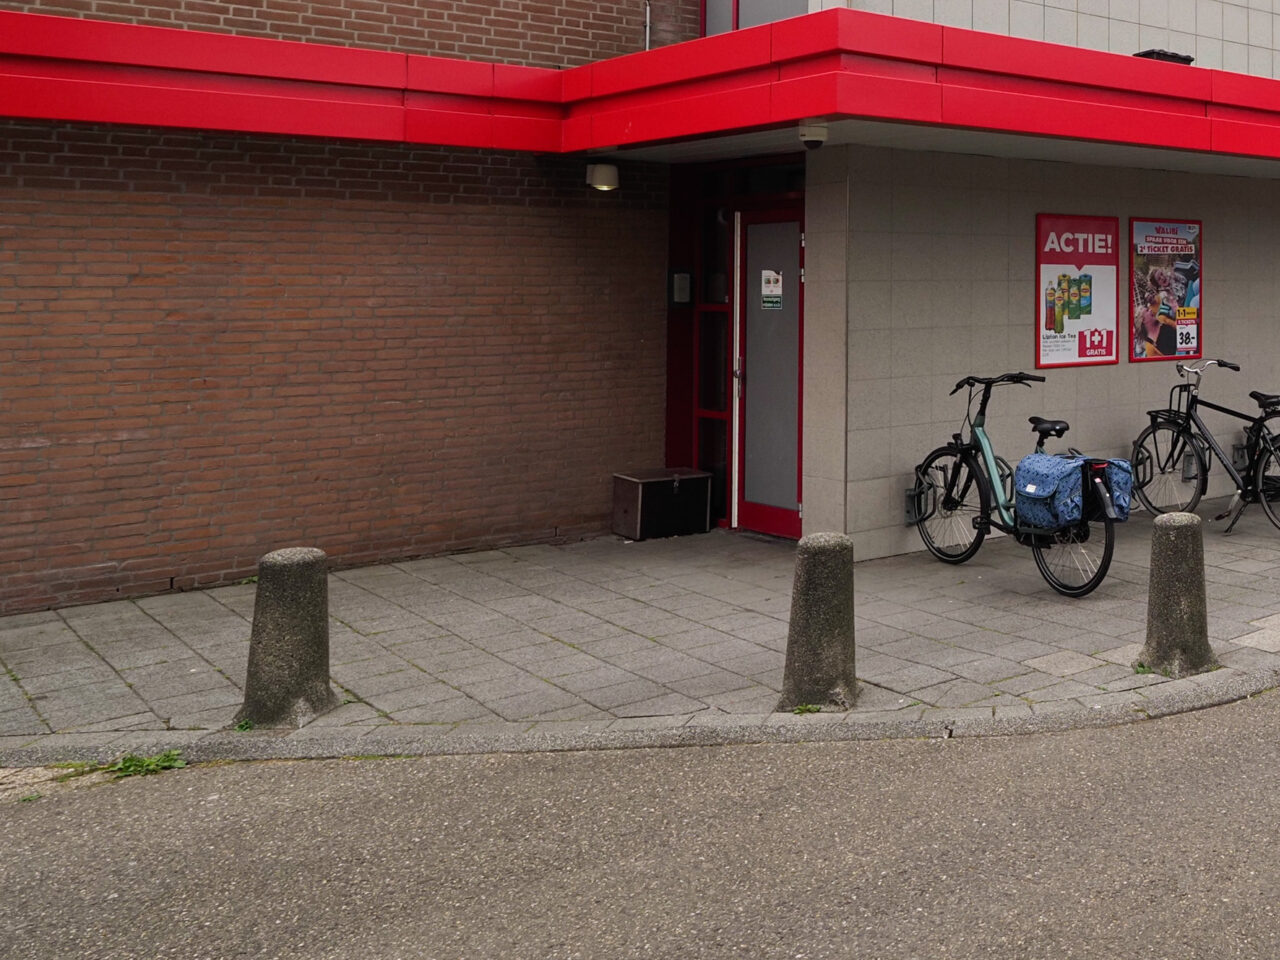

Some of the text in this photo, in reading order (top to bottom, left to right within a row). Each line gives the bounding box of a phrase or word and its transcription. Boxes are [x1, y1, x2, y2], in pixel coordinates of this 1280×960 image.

[1044, 232, 1112, 254] ACTIE!
[1147, 245, 1169, 253] TICKET
[1170, 245, 1193, 253] GRATIS
[1083, 329, 1107, 348] 1+1
